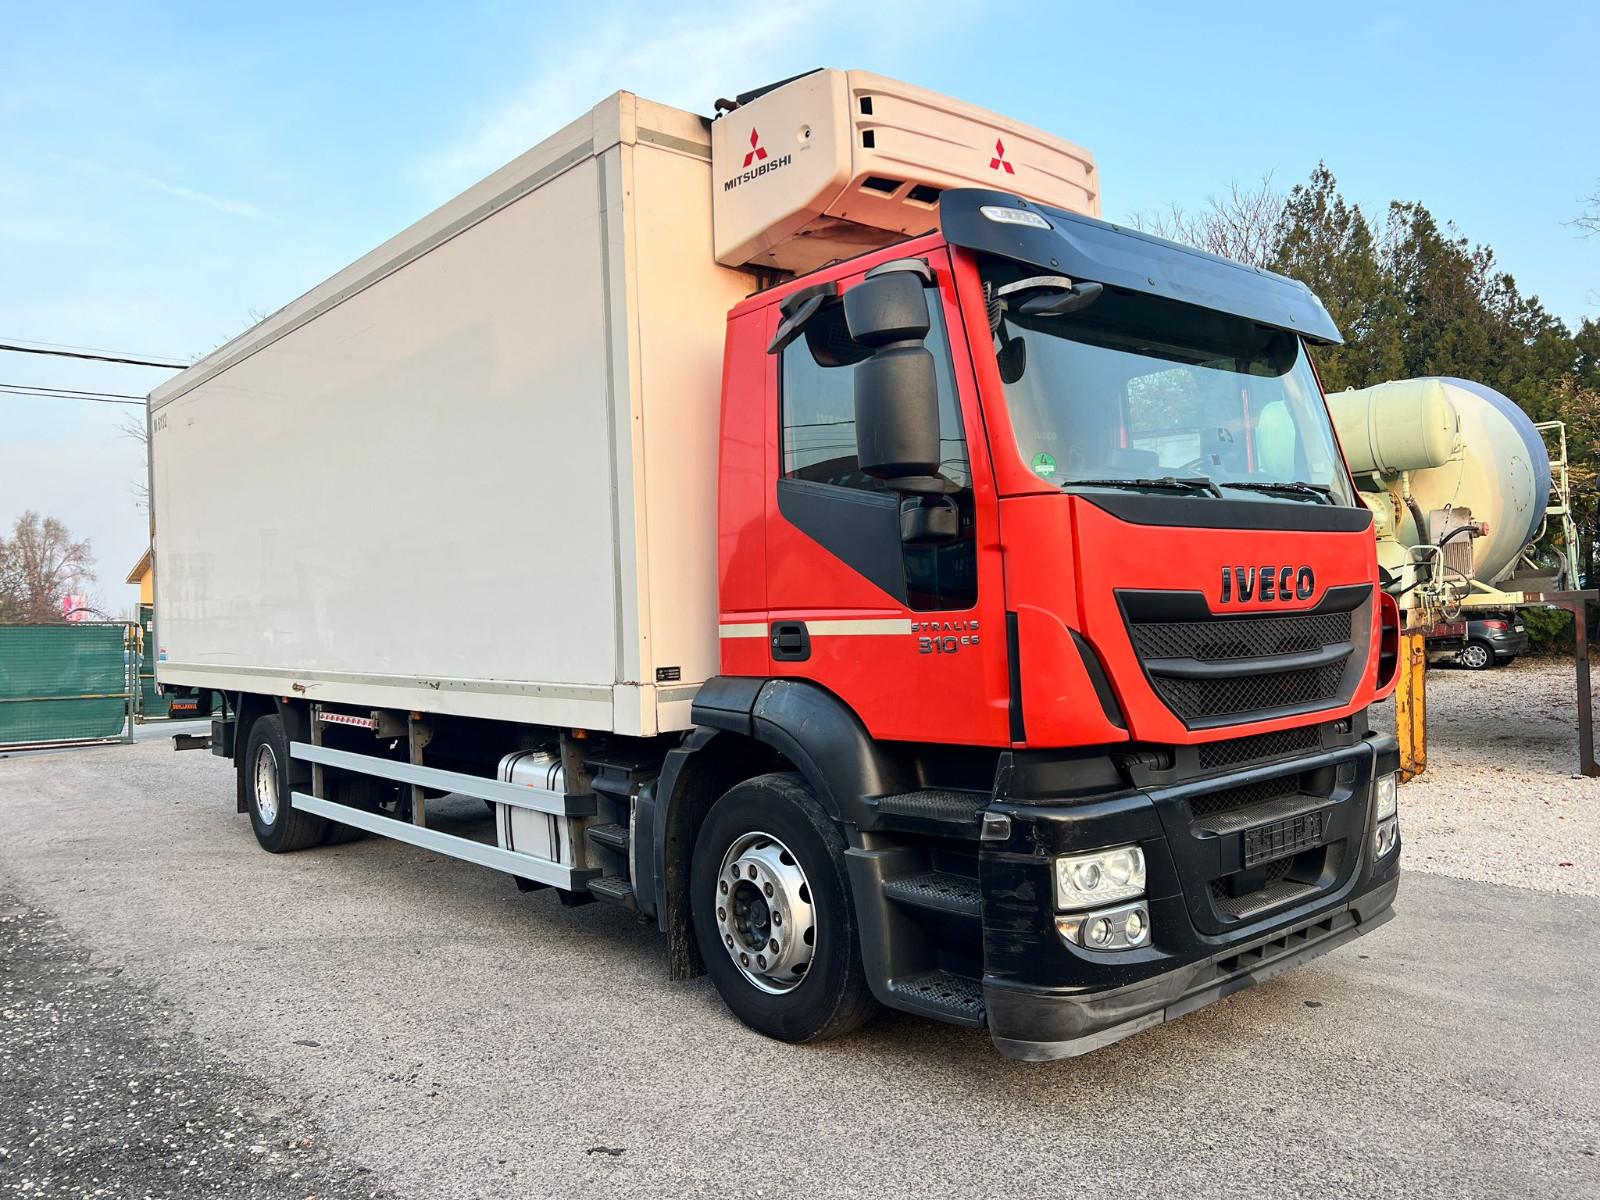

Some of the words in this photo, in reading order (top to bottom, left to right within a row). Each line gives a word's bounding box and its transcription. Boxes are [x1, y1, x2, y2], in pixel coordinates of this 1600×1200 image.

[724, 154, 791, 192] MITSUBISHI
[1220, 564, 1315, 604] IVECO
[911, 619, 980, 632] STRALIS
